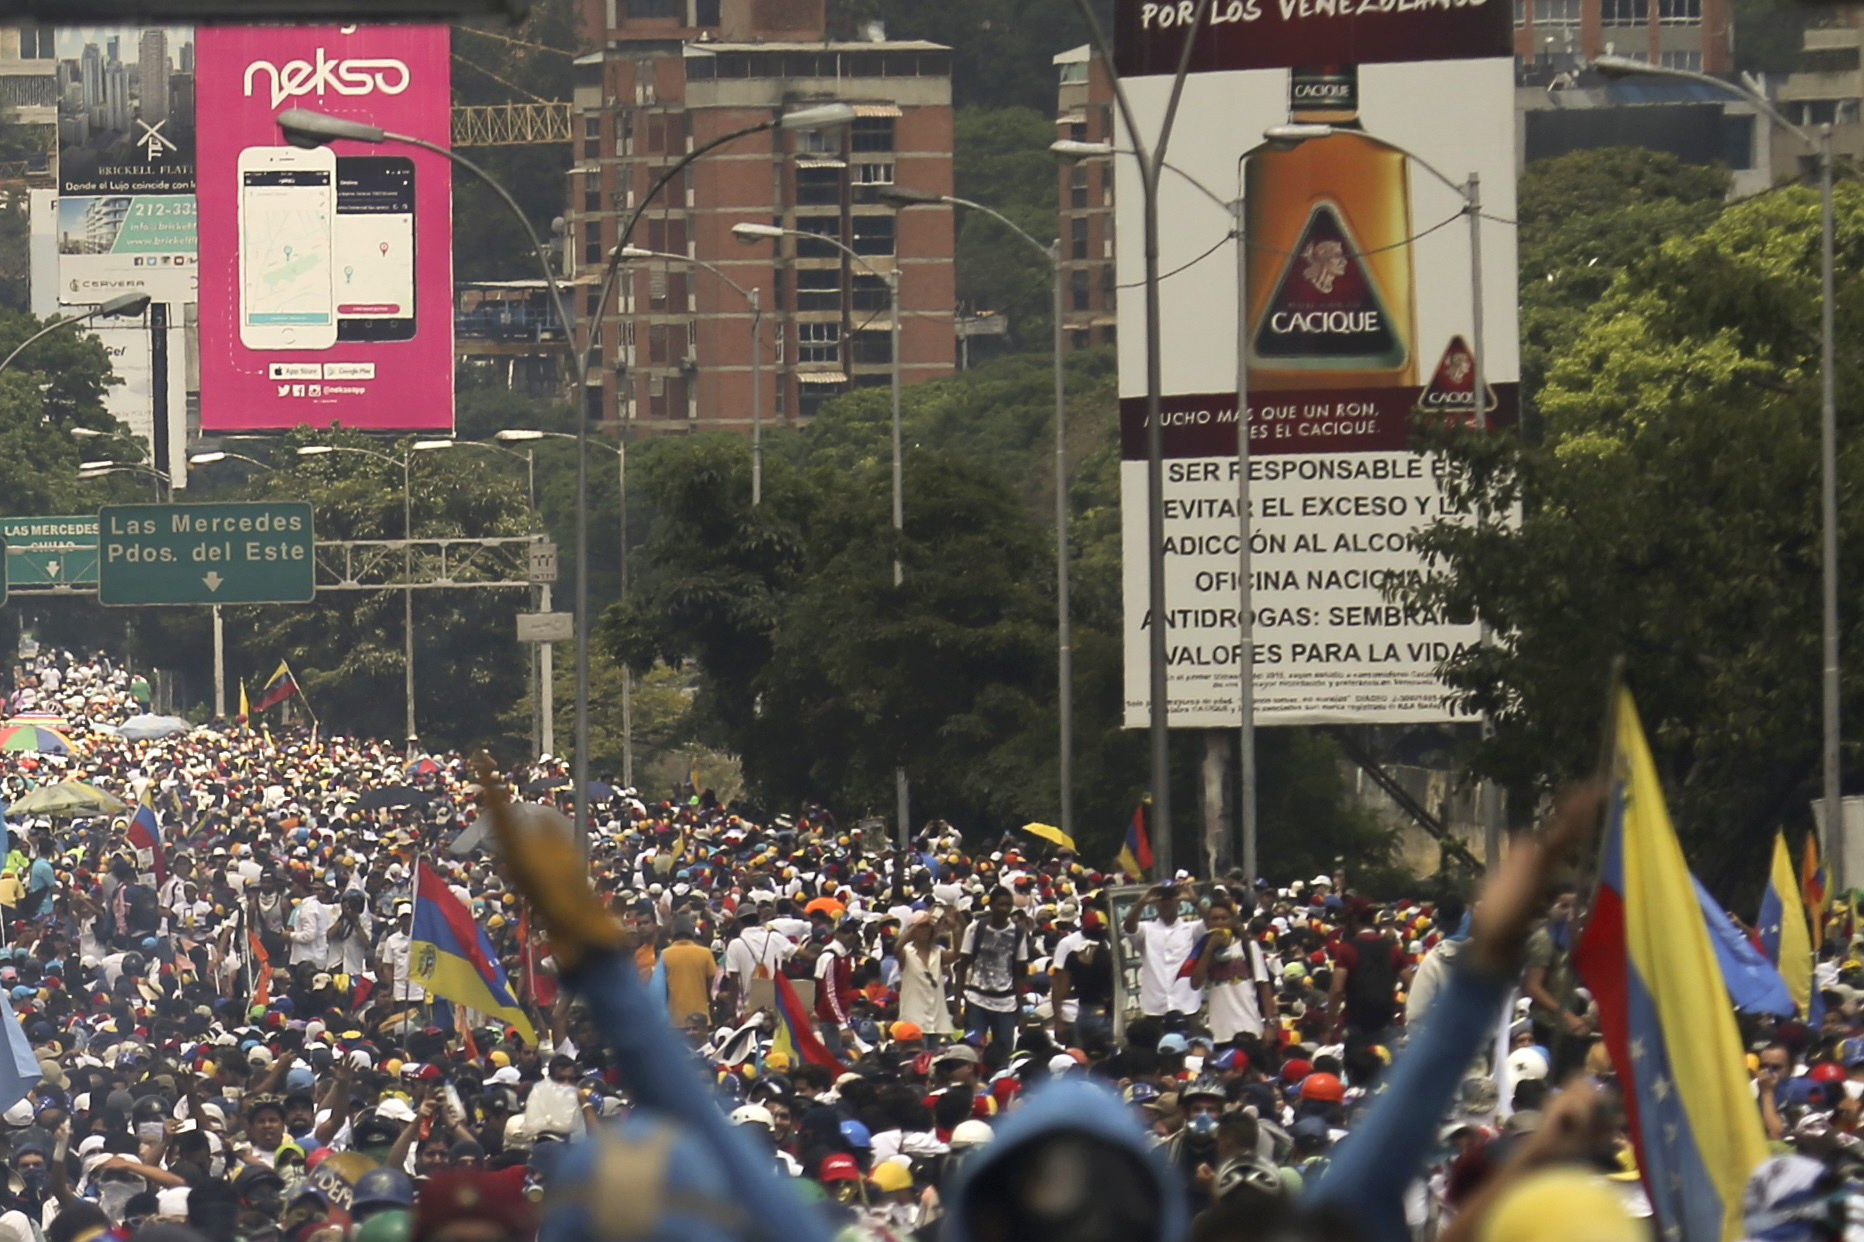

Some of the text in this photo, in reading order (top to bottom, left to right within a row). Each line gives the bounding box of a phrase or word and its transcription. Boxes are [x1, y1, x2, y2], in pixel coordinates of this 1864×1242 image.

[1142, 2, 1194, 28] POR
[1210, 0, 1262, 24] LOS
[244, 48, 410, 109] nekso
[1294, 84, 1350, 97] CACIQUE
[98, 166, 154, 175] BRICKELL
[66, 182, 96, 191] Donde
[99, 181, 108, 190] el
[110, 180, 130, 192] Lujo
[132, 180, 170, 190] coincide
[172, 180, 189, 189] con
[83, 280, 145, 288] CERVERA
[1271, 311, 1381, 334] CACIQUE
[1144, 411, 1211, 427] UCHO
[1261, 406, 1297, 420] QUE
[1303, 404, 1330, 418] UN
[1336, 403, 1380, 417] RON,
[1249, 424, 1268, 439] ES
[1275, 424, 1293, 438] EL
[1169, 463, 1220, 483] SER
[1262, 497, 1294, 517] EL
[1302, 496, 1407, 517] EXCESO
[1414, 497, 1431, 515] Y
[4, 524, 99, 536] LAS MERCEDES
[111, 512, 302, 535] Las Mercedes
[108, 541, 305, 563] Pdos. del Este
[1163, 529, 1286, 556] ADICCÓN
[1293, 534, 1327, 553] AL
[1291, 642, 1362, 662] PARA
[1368, 642, 1401, 662] LA
